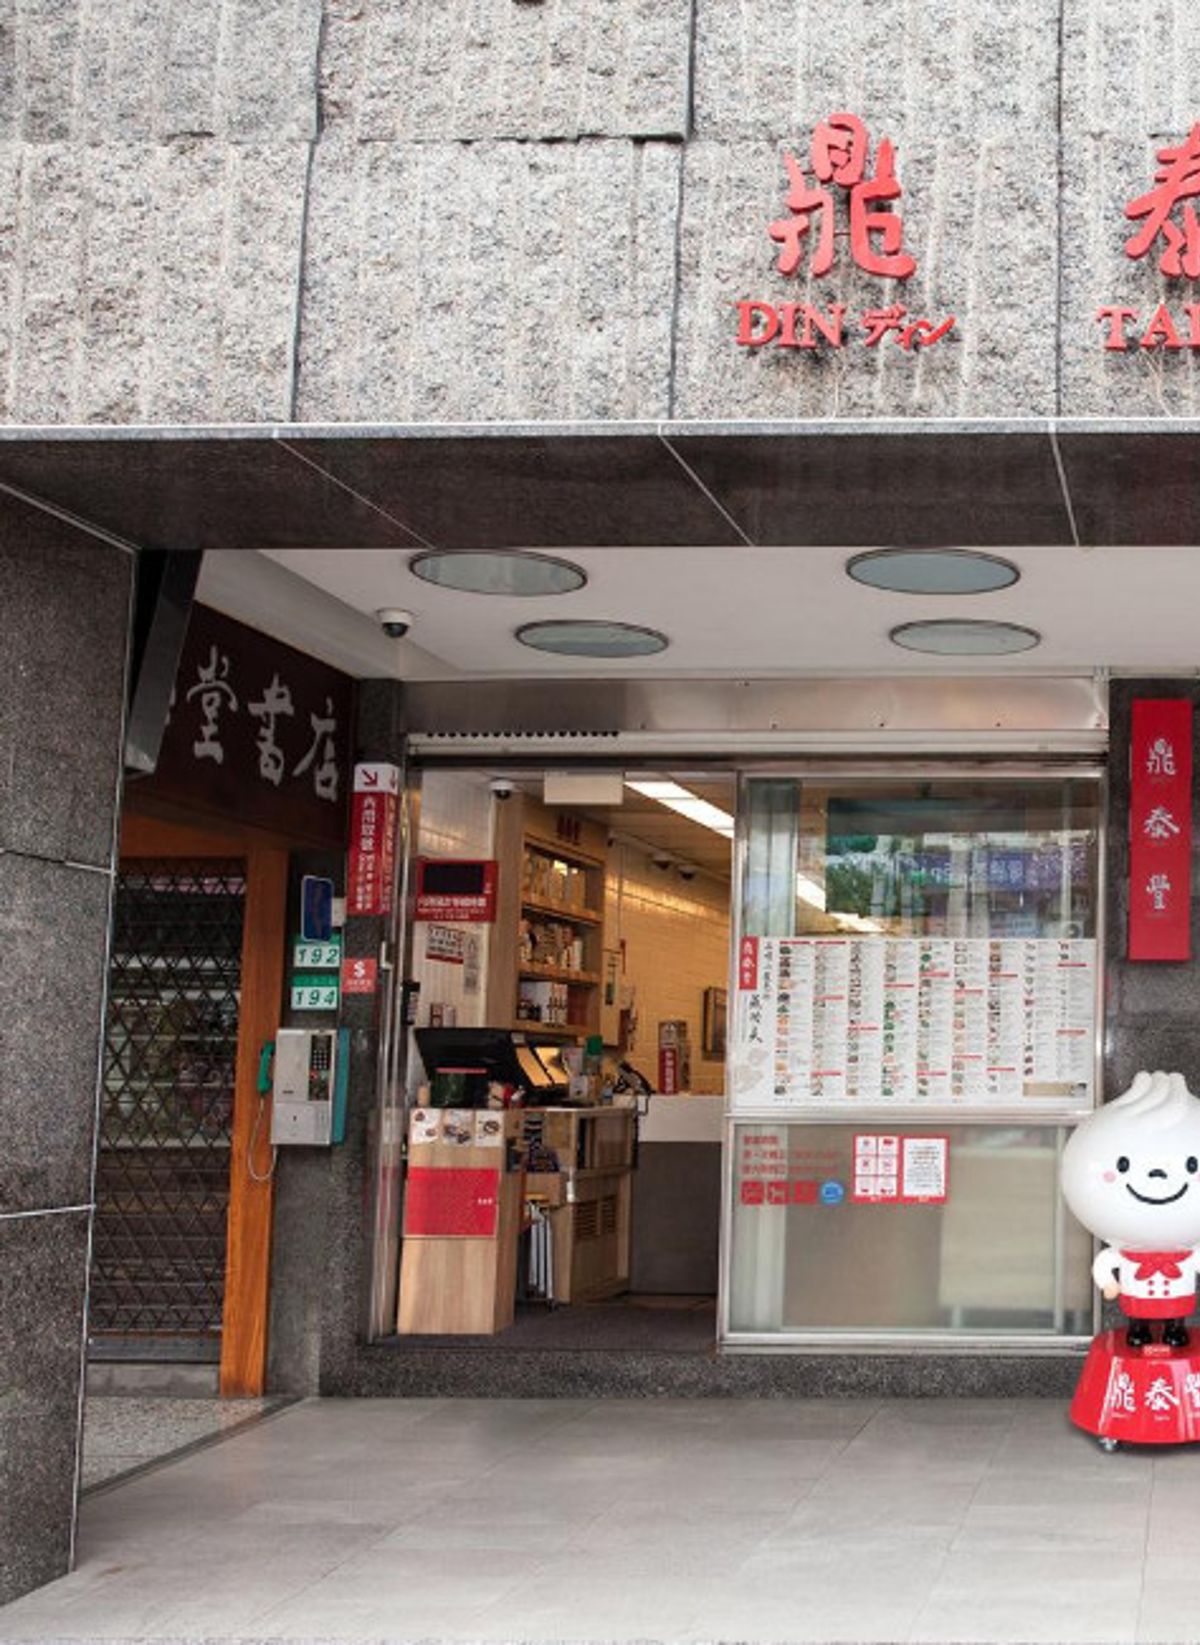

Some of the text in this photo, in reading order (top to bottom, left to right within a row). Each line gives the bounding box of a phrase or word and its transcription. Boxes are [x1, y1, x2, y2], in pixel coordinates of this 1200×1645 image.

[736, 300, 845, 349] DIN
[862, 306, 956, 350] ディン
[170, 645, 341, 801] 堂書店
[1145, 738, 1181, 911] 鼎泰豐
[298, 947, 338, 965] 192
[295, 988, 336, 1006] 194
